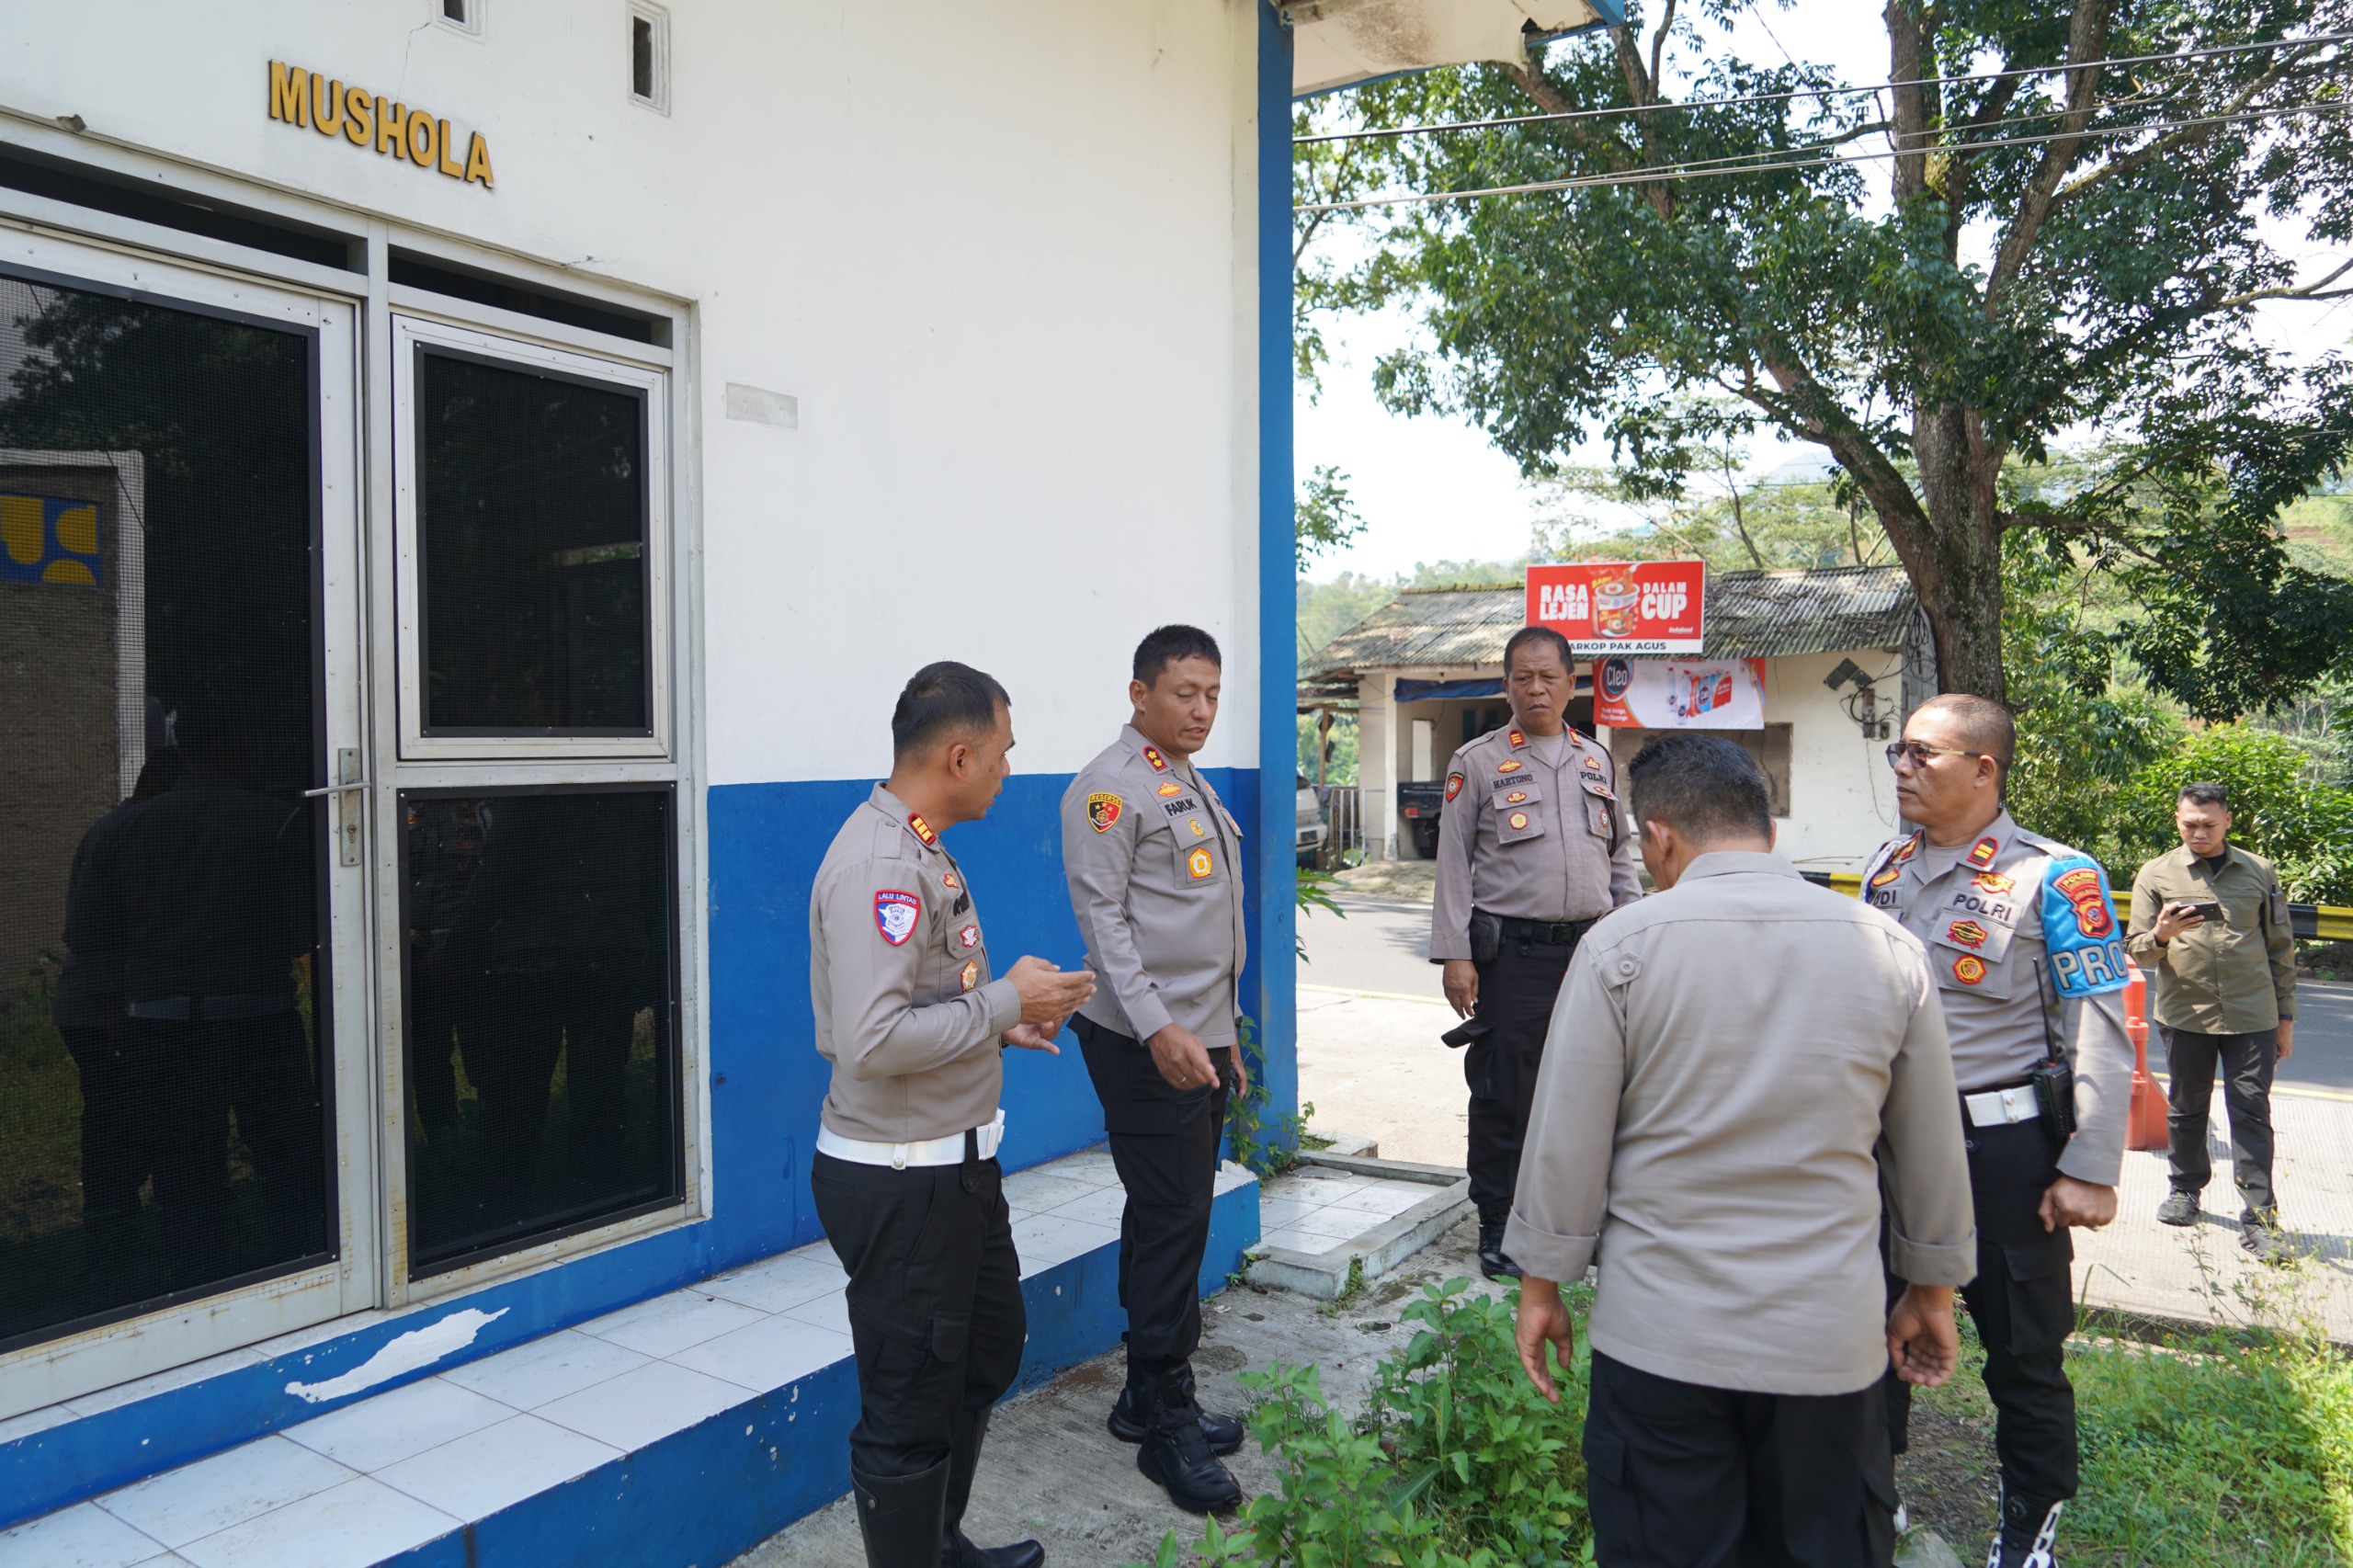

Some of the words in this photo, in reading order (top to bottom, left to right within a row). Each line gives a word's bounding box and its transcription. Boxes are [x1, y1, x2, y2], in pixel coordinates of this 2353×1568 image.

[269, 59, 494, 189] MUSHOLA
[1540, 585, 1588, 602] RASA
[1643, 582, 1687, 594] DALAM
[1540, 602, 1589, 620] LEJEN
[1641, 594, 1688, 620] CUP
[1636, 642, 1666, 650] AGUS
[1606, 665, 1628, 687] Cleo
[1494, 774, 1533, 789] HARTONO
[1580, 771, 1608, 785] POLRI
[1090, 794, 1121, 805] RESERSE
[1165, 798, 1197, 817] FARUK
[2063, 872, 2096, 887] POLRES
[896, 893, 917, 905] LINTAS
[1952, 892, 2012, 922] POLRI
